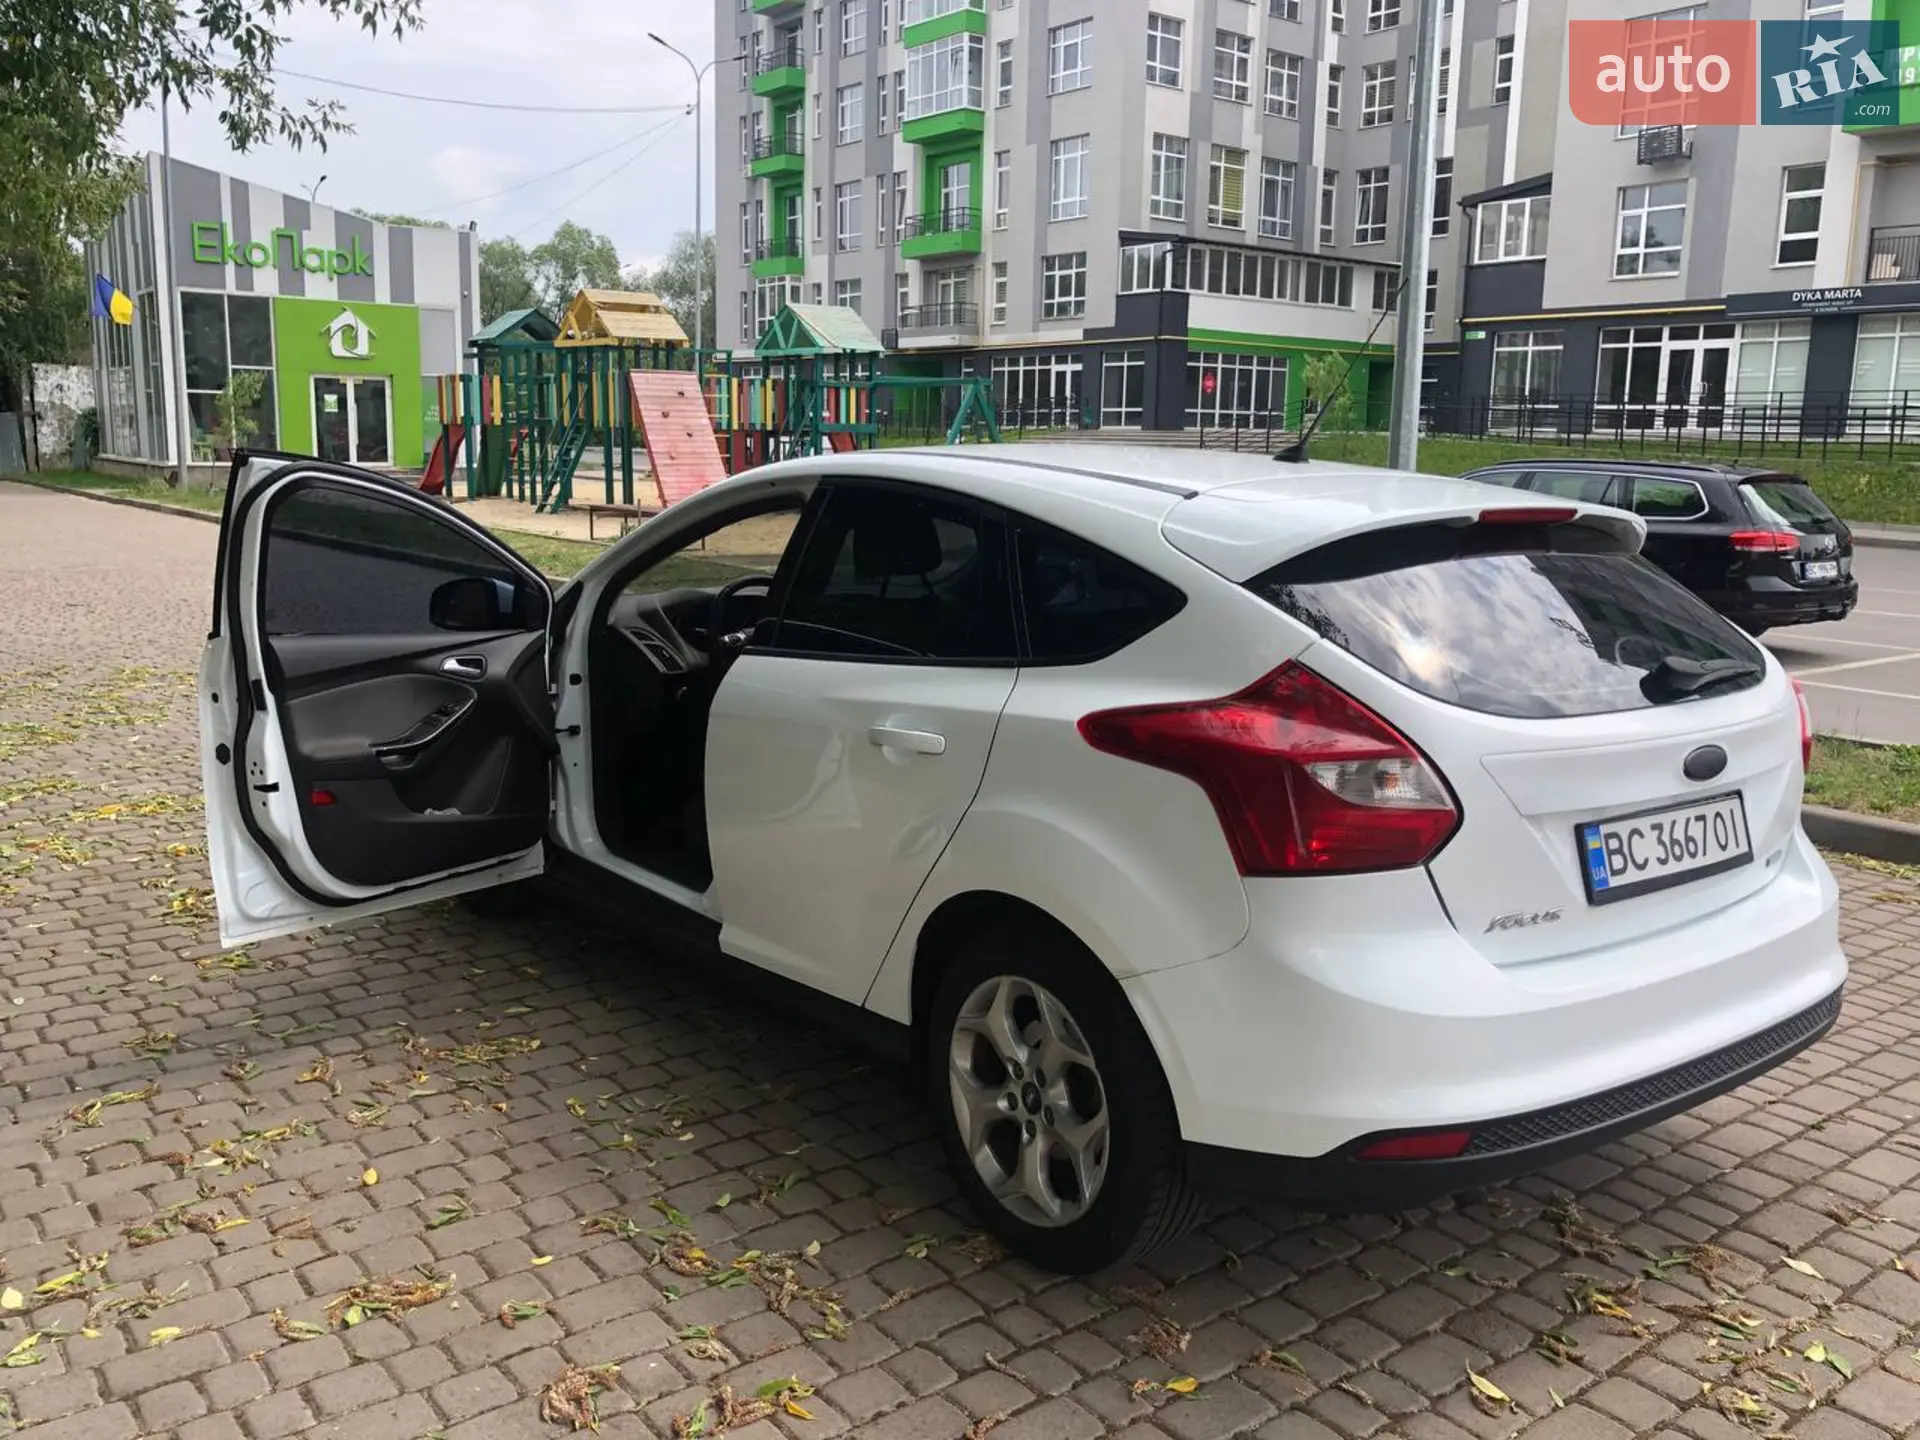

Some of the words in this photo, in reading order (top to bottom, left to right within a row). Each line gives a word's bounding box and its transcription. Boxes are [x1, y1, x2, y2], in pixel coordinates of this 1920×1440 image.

[1792, 292, 1821, 302] DYKA
[1824, 288, 1862, 300] MARTA
[1650, 813, 1708, 867] 3667
[1592, 867, 1608, 881] UA
